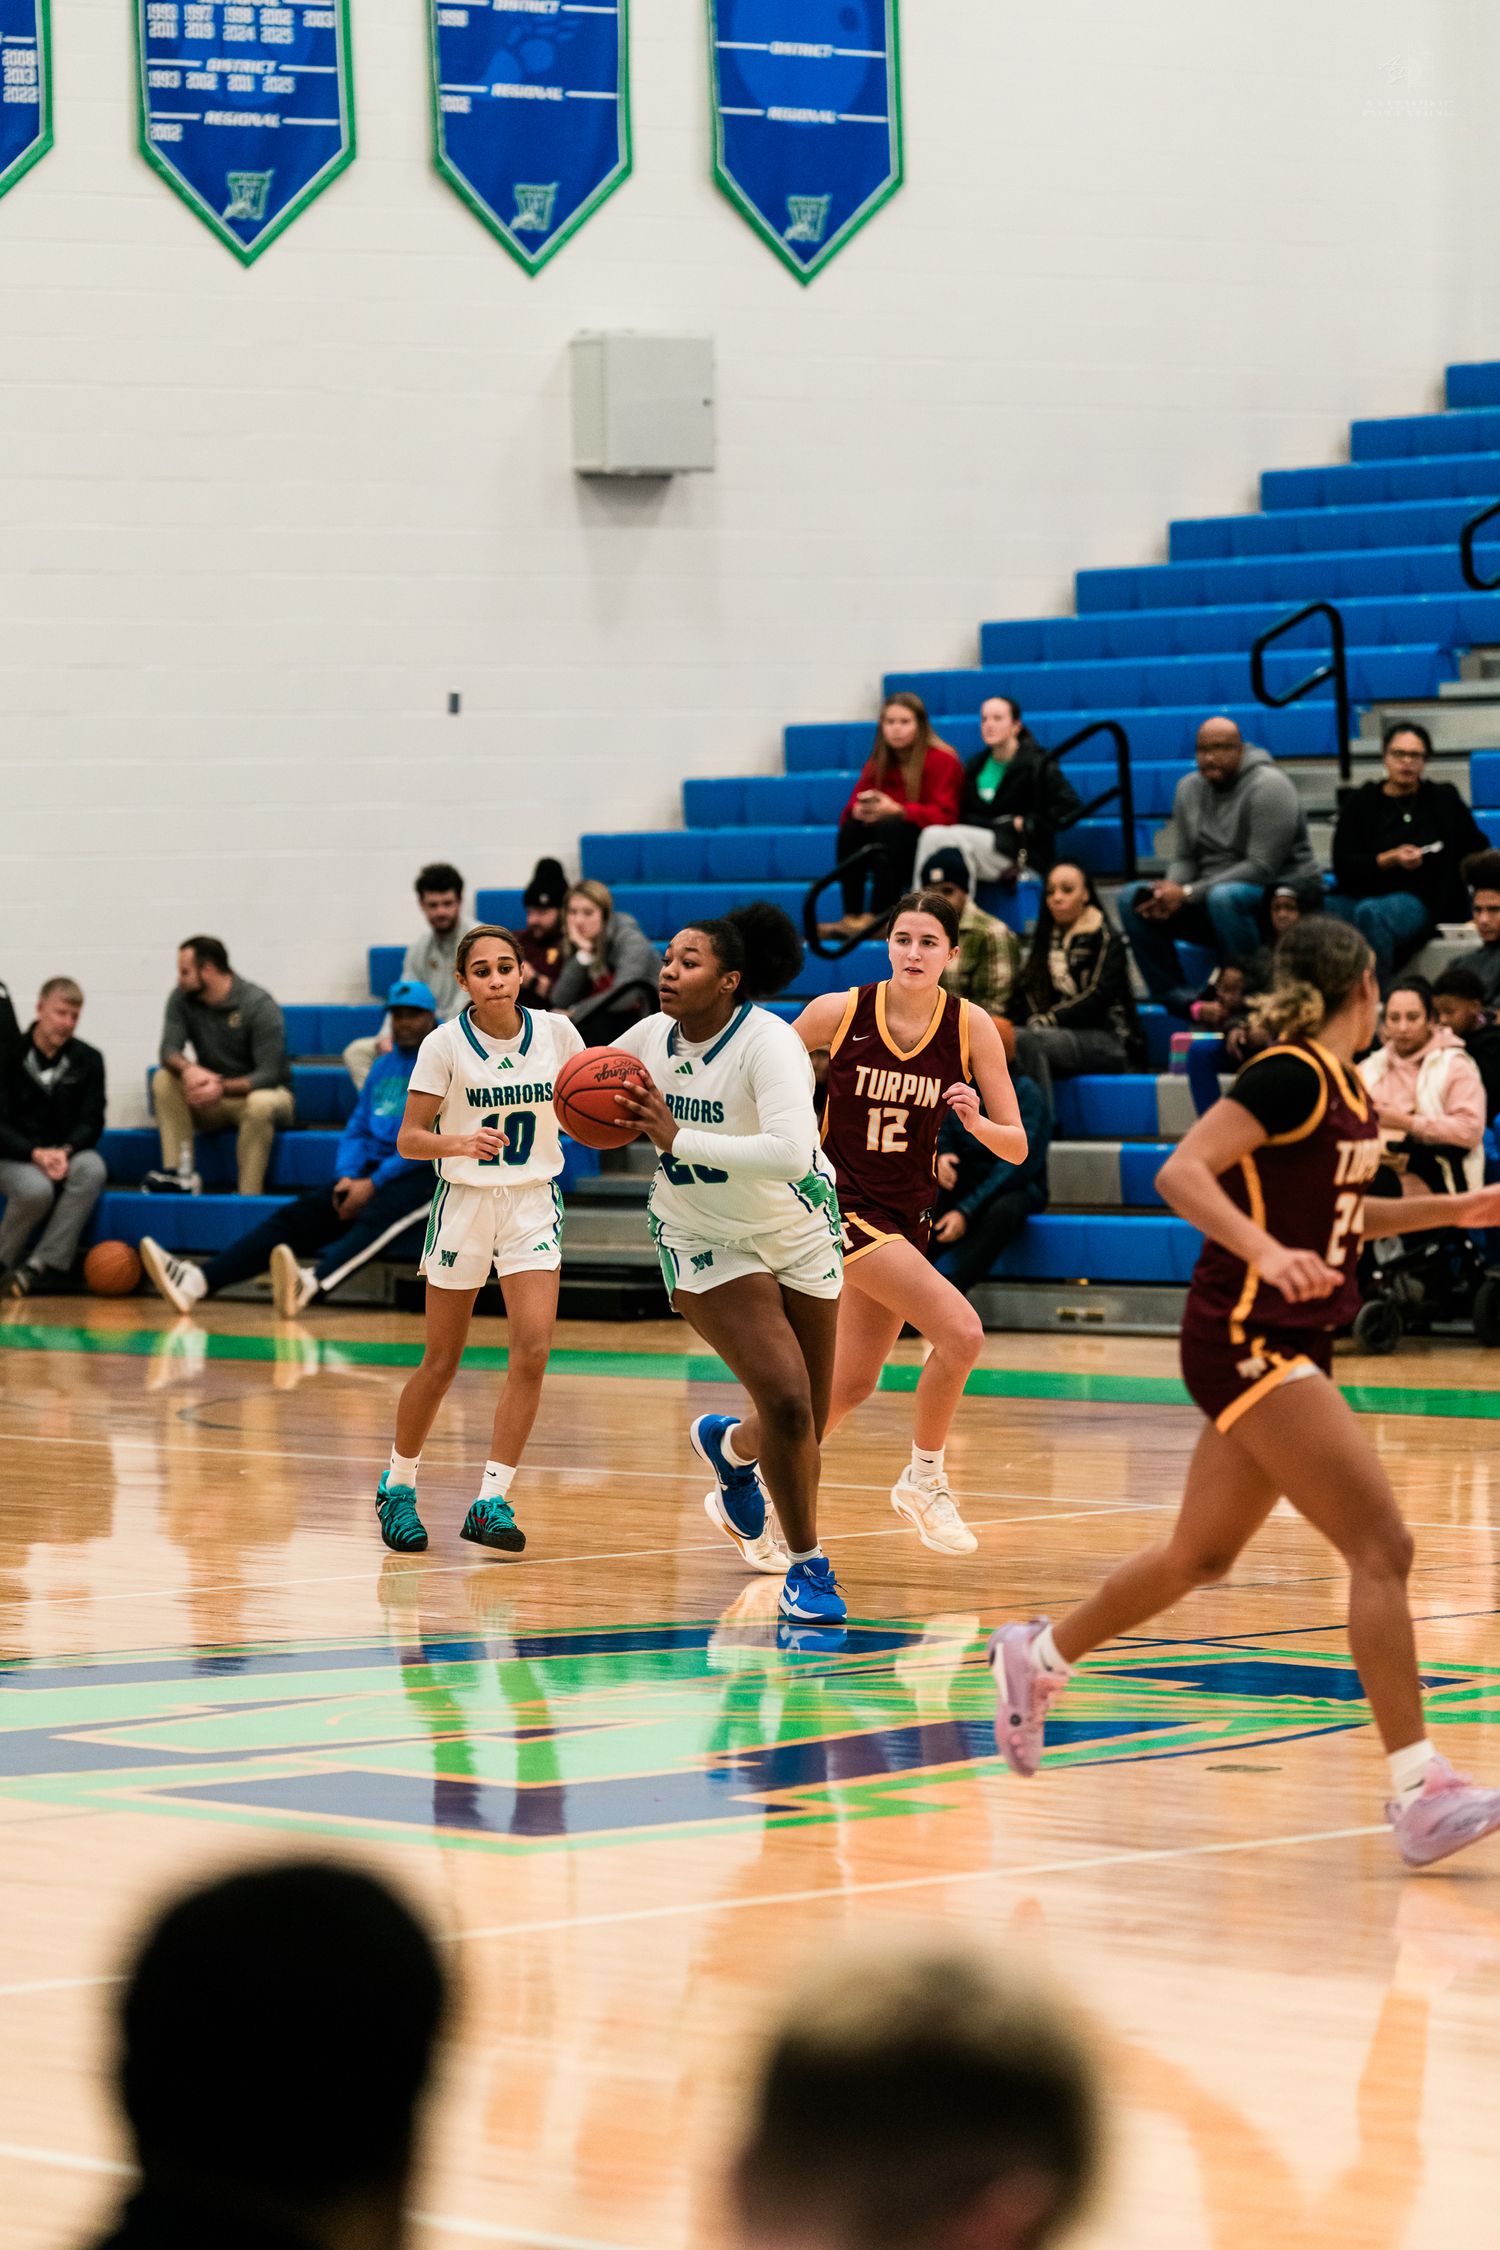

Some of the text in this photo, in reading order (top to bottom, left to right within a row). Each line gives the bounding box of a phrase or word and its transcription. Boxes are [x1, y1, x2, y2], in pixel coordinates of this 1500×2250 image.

[206, 58, 278, 74] DISTRICT
[491, 83, 563, 101] REGIONAL
[204, 110, 281, 128] REGIONAL
[465, 1082, 553, 1108] WARRIORS
[854, 1065, 941, 1109] TURPIN
[666, 1093, 725, 1124] RRIORS
[478, 1111, 536, 1166] 10
[866, 1107, 910, 1153] 12
